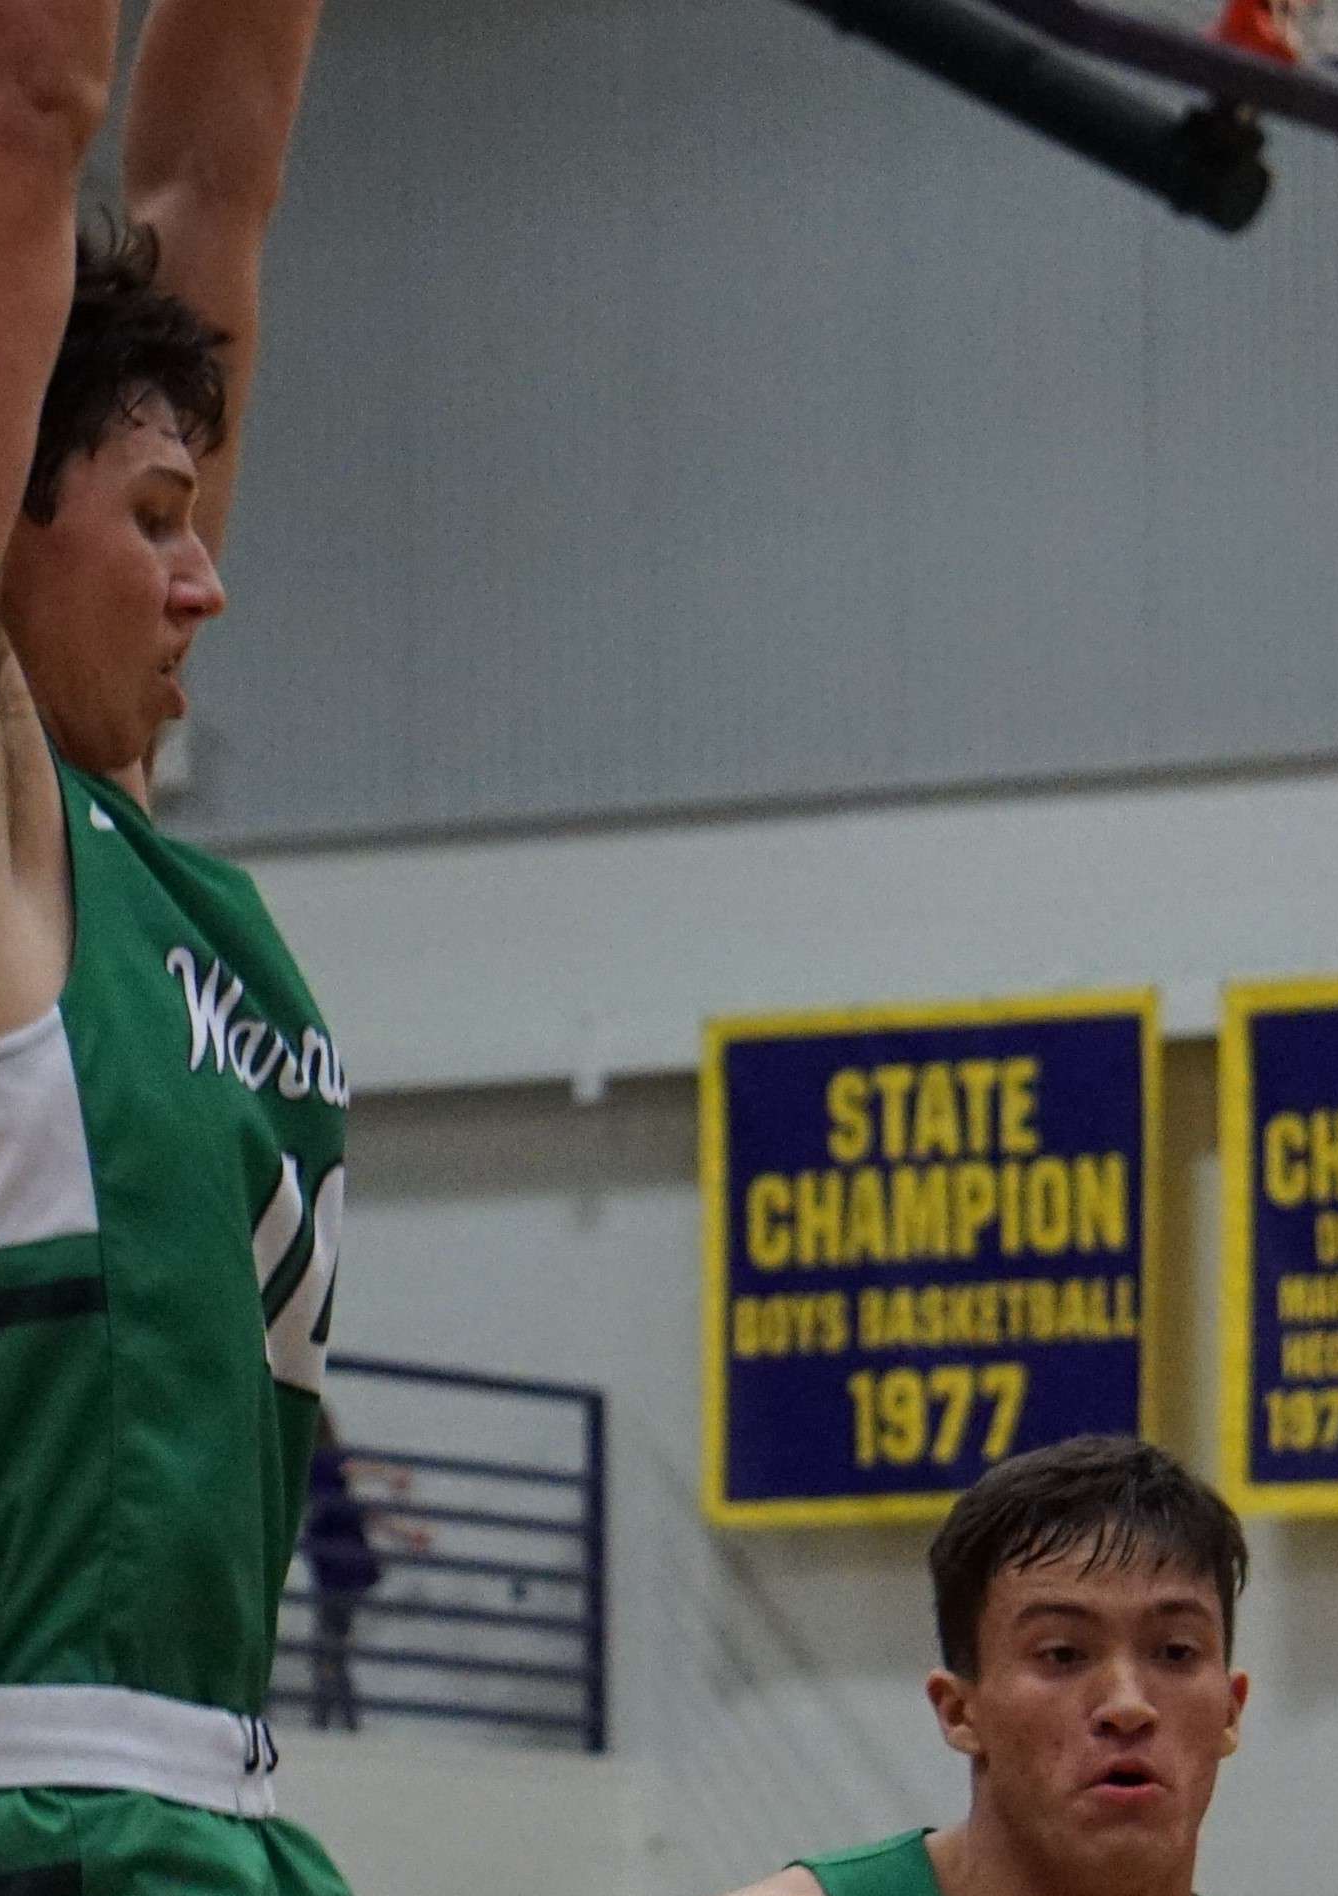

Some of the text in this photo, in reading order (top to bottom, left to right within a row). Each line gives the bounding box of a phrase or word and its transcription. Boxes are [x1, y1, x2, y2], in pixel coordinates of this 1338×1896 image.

[826, 1058, 1040, 1164] STATE
[746, 1152, 1128, 1270] CHAMPION
[730, 1278, 1137, 1358] BOYS BASKETBALL
[848, 1362, 1029, 1466] 1977
